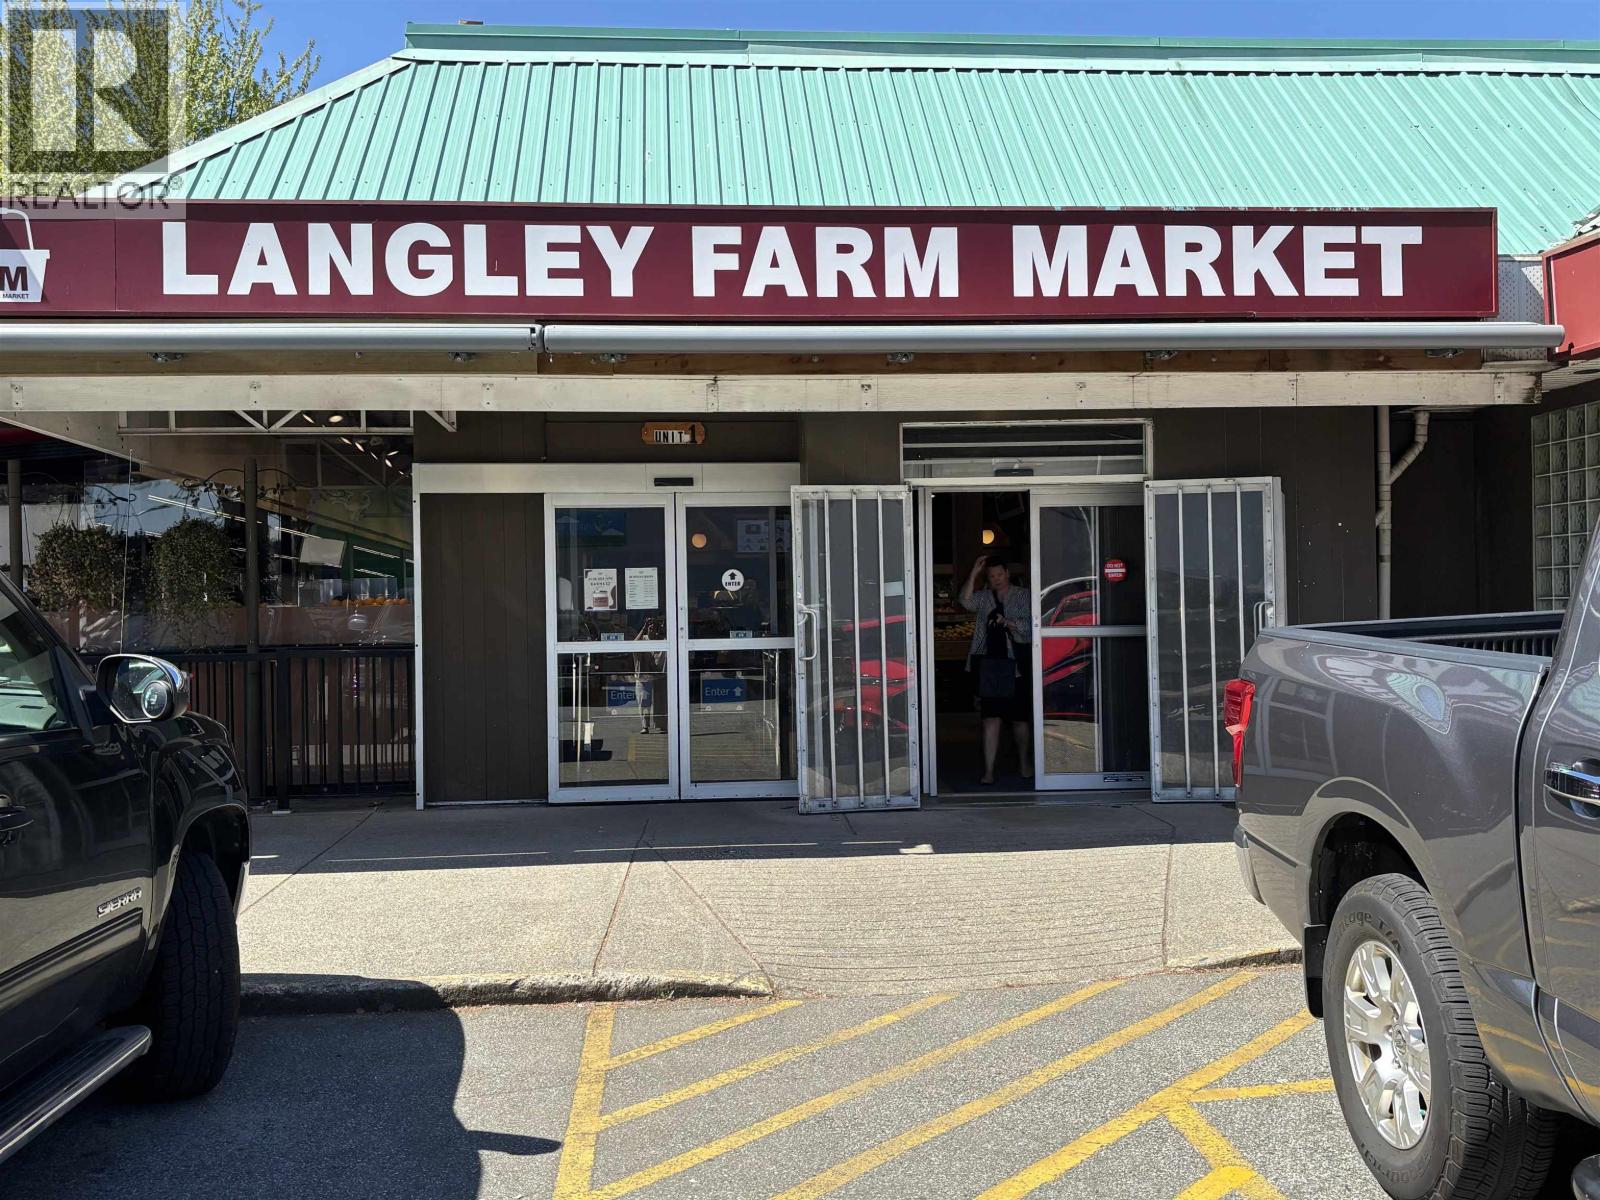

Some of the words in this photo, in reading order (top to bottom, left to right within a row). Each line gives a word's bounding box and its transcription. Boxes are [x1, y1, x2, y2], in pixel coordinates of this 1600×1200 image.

[162, 221, 655, 298] LANGLEY
[691, 225, 959, 298] FARM
[1012, 225, 1423, 298] MARKET
[655, 430, 684, 443] UNIT
[610, 690, 636, 700] Enter
[704, 687, 731, 697] Enter
[97, 887, 142, 918] SIERRA
